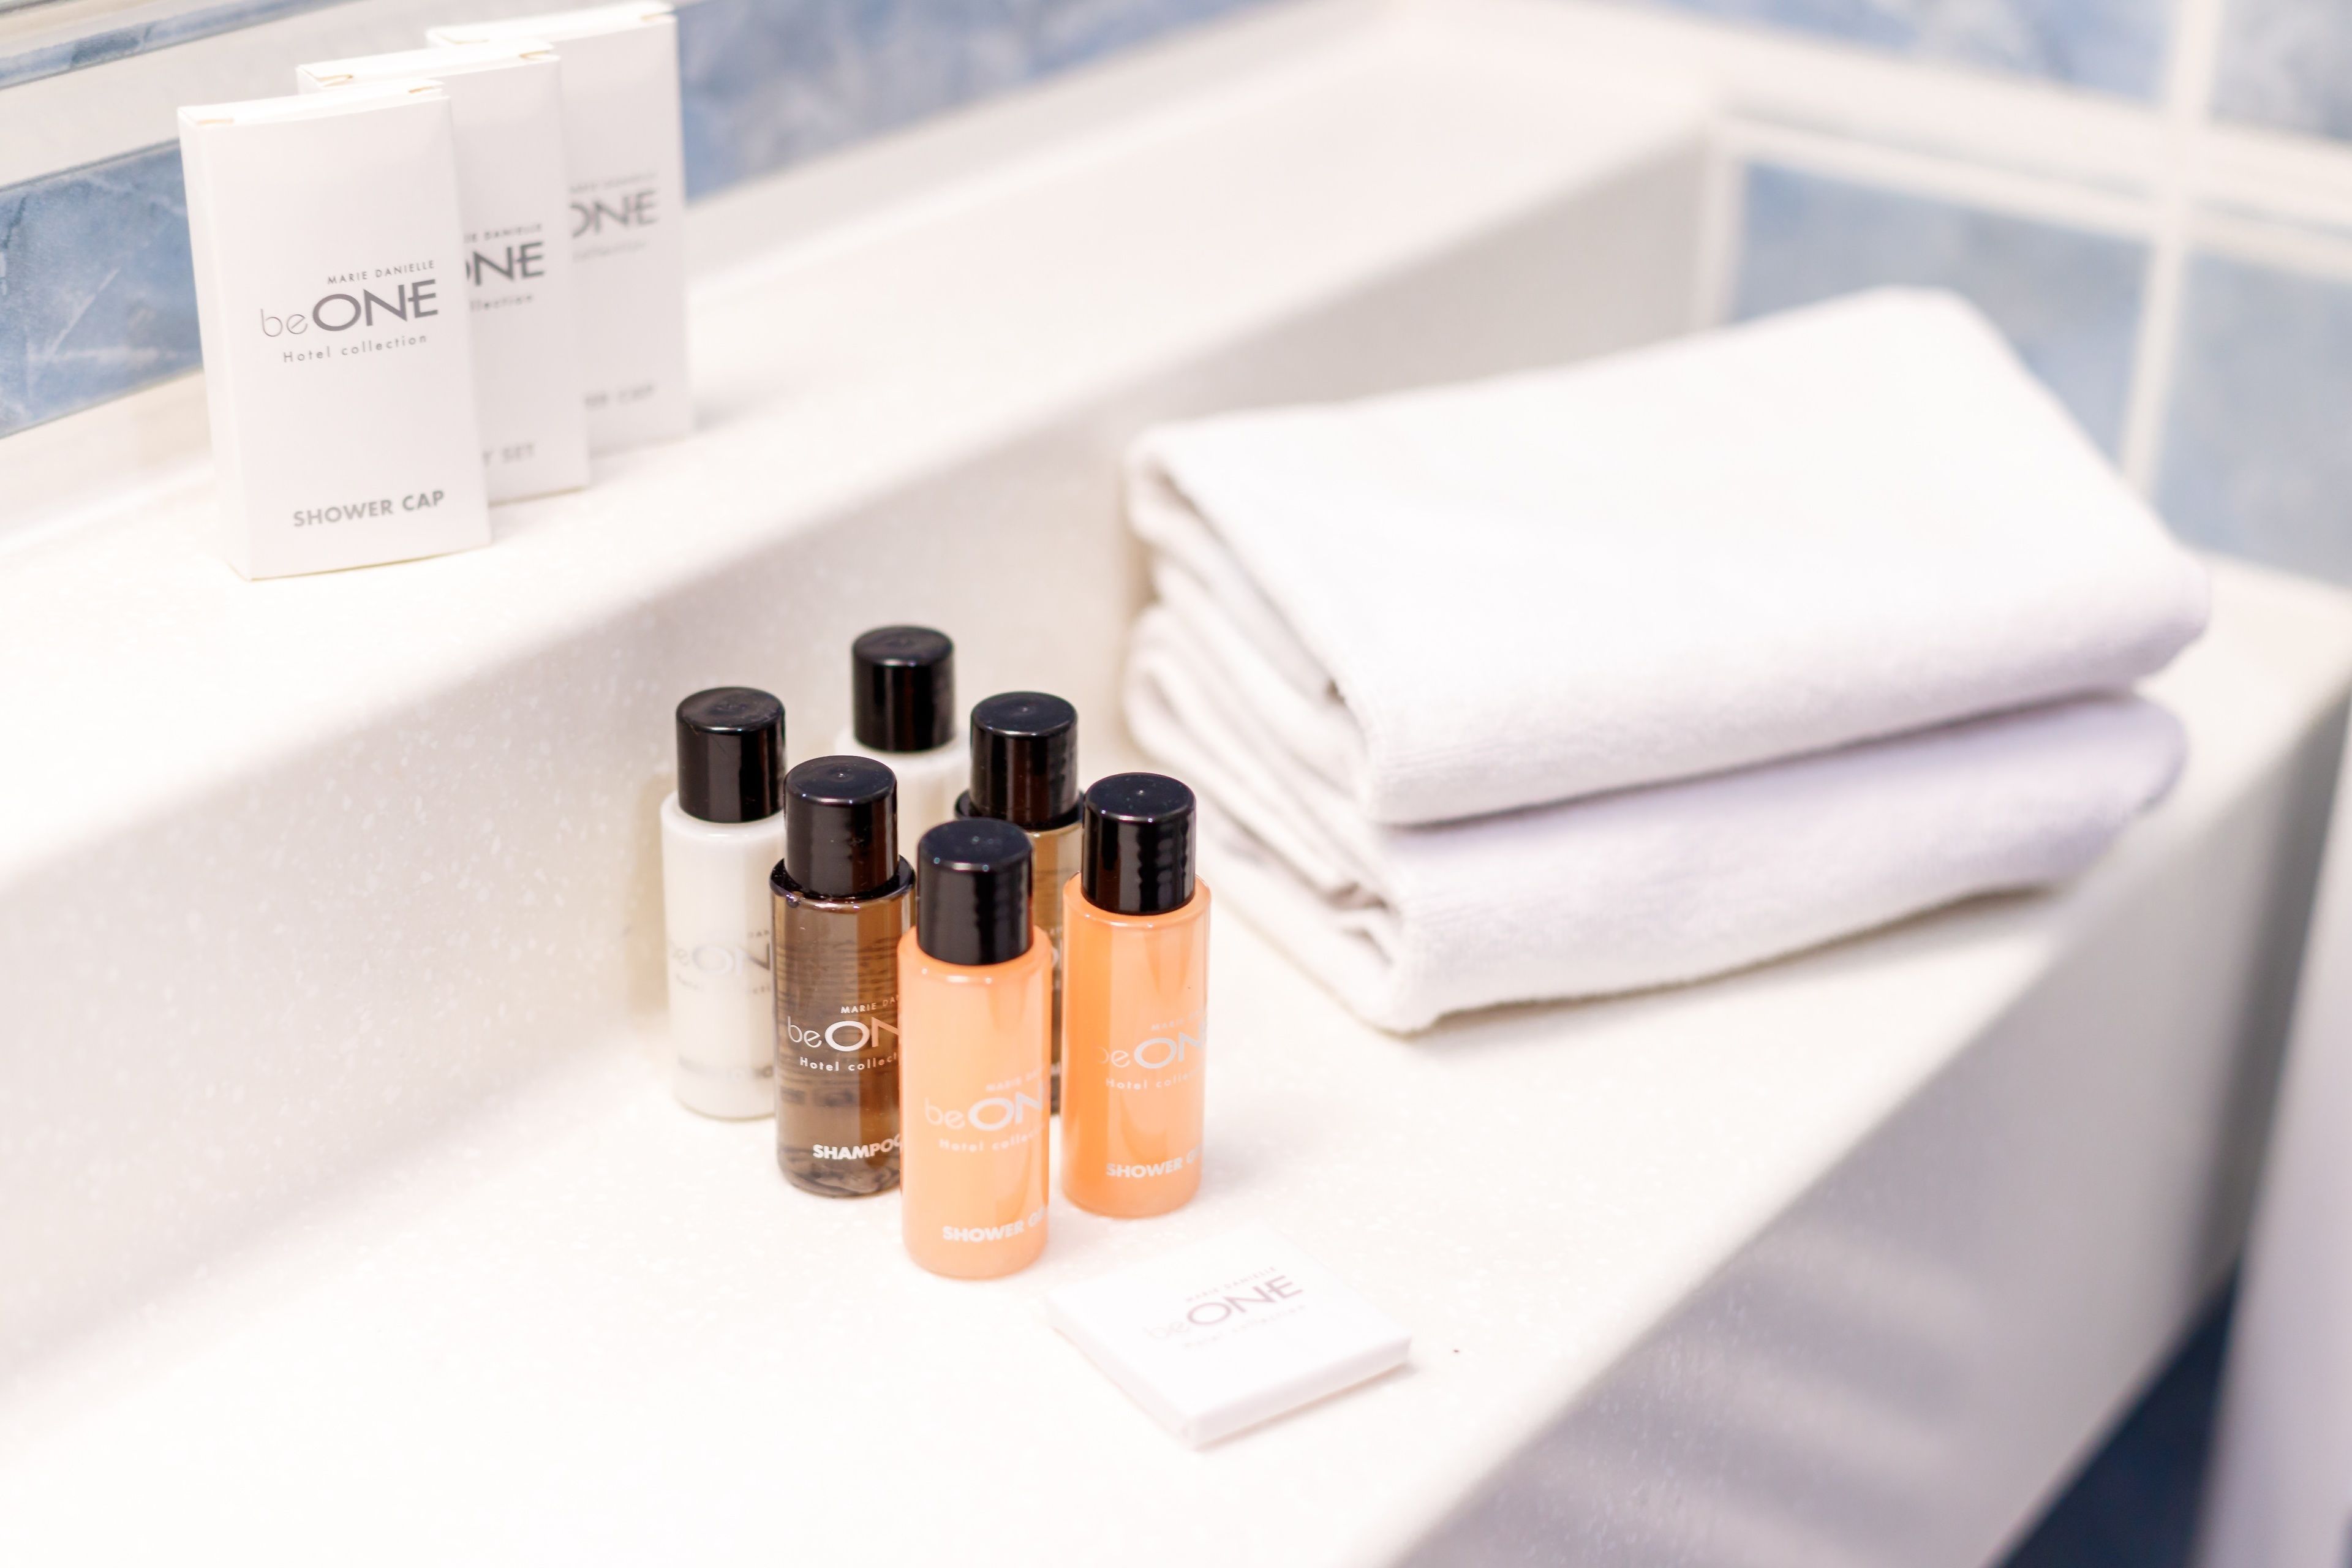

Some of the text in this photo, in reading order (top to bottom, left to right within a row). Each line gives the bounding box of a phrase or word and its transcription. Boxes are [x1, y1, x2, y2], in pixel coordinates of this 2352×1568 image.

[327, 260, 435, 285] MARIE DANIELLE
[464, 240, 546, 287] NE
[260, 279, 439, 337] beONE
[283, 334, 428, 363] Hotel collection
[293, 490, 445, 527] SHOWER CAP
[840, 1003, 877, 1014] MARIE
[799, 1056, 840, 1072] Hotel
[1106, 1077, 1148, 1091] Hotel
[937, 1137, 985, 1154] Hotel
[1106, 1156, 1183, 1179] SHOWER
[941, 1219, 1025, 1245] SHOWER
